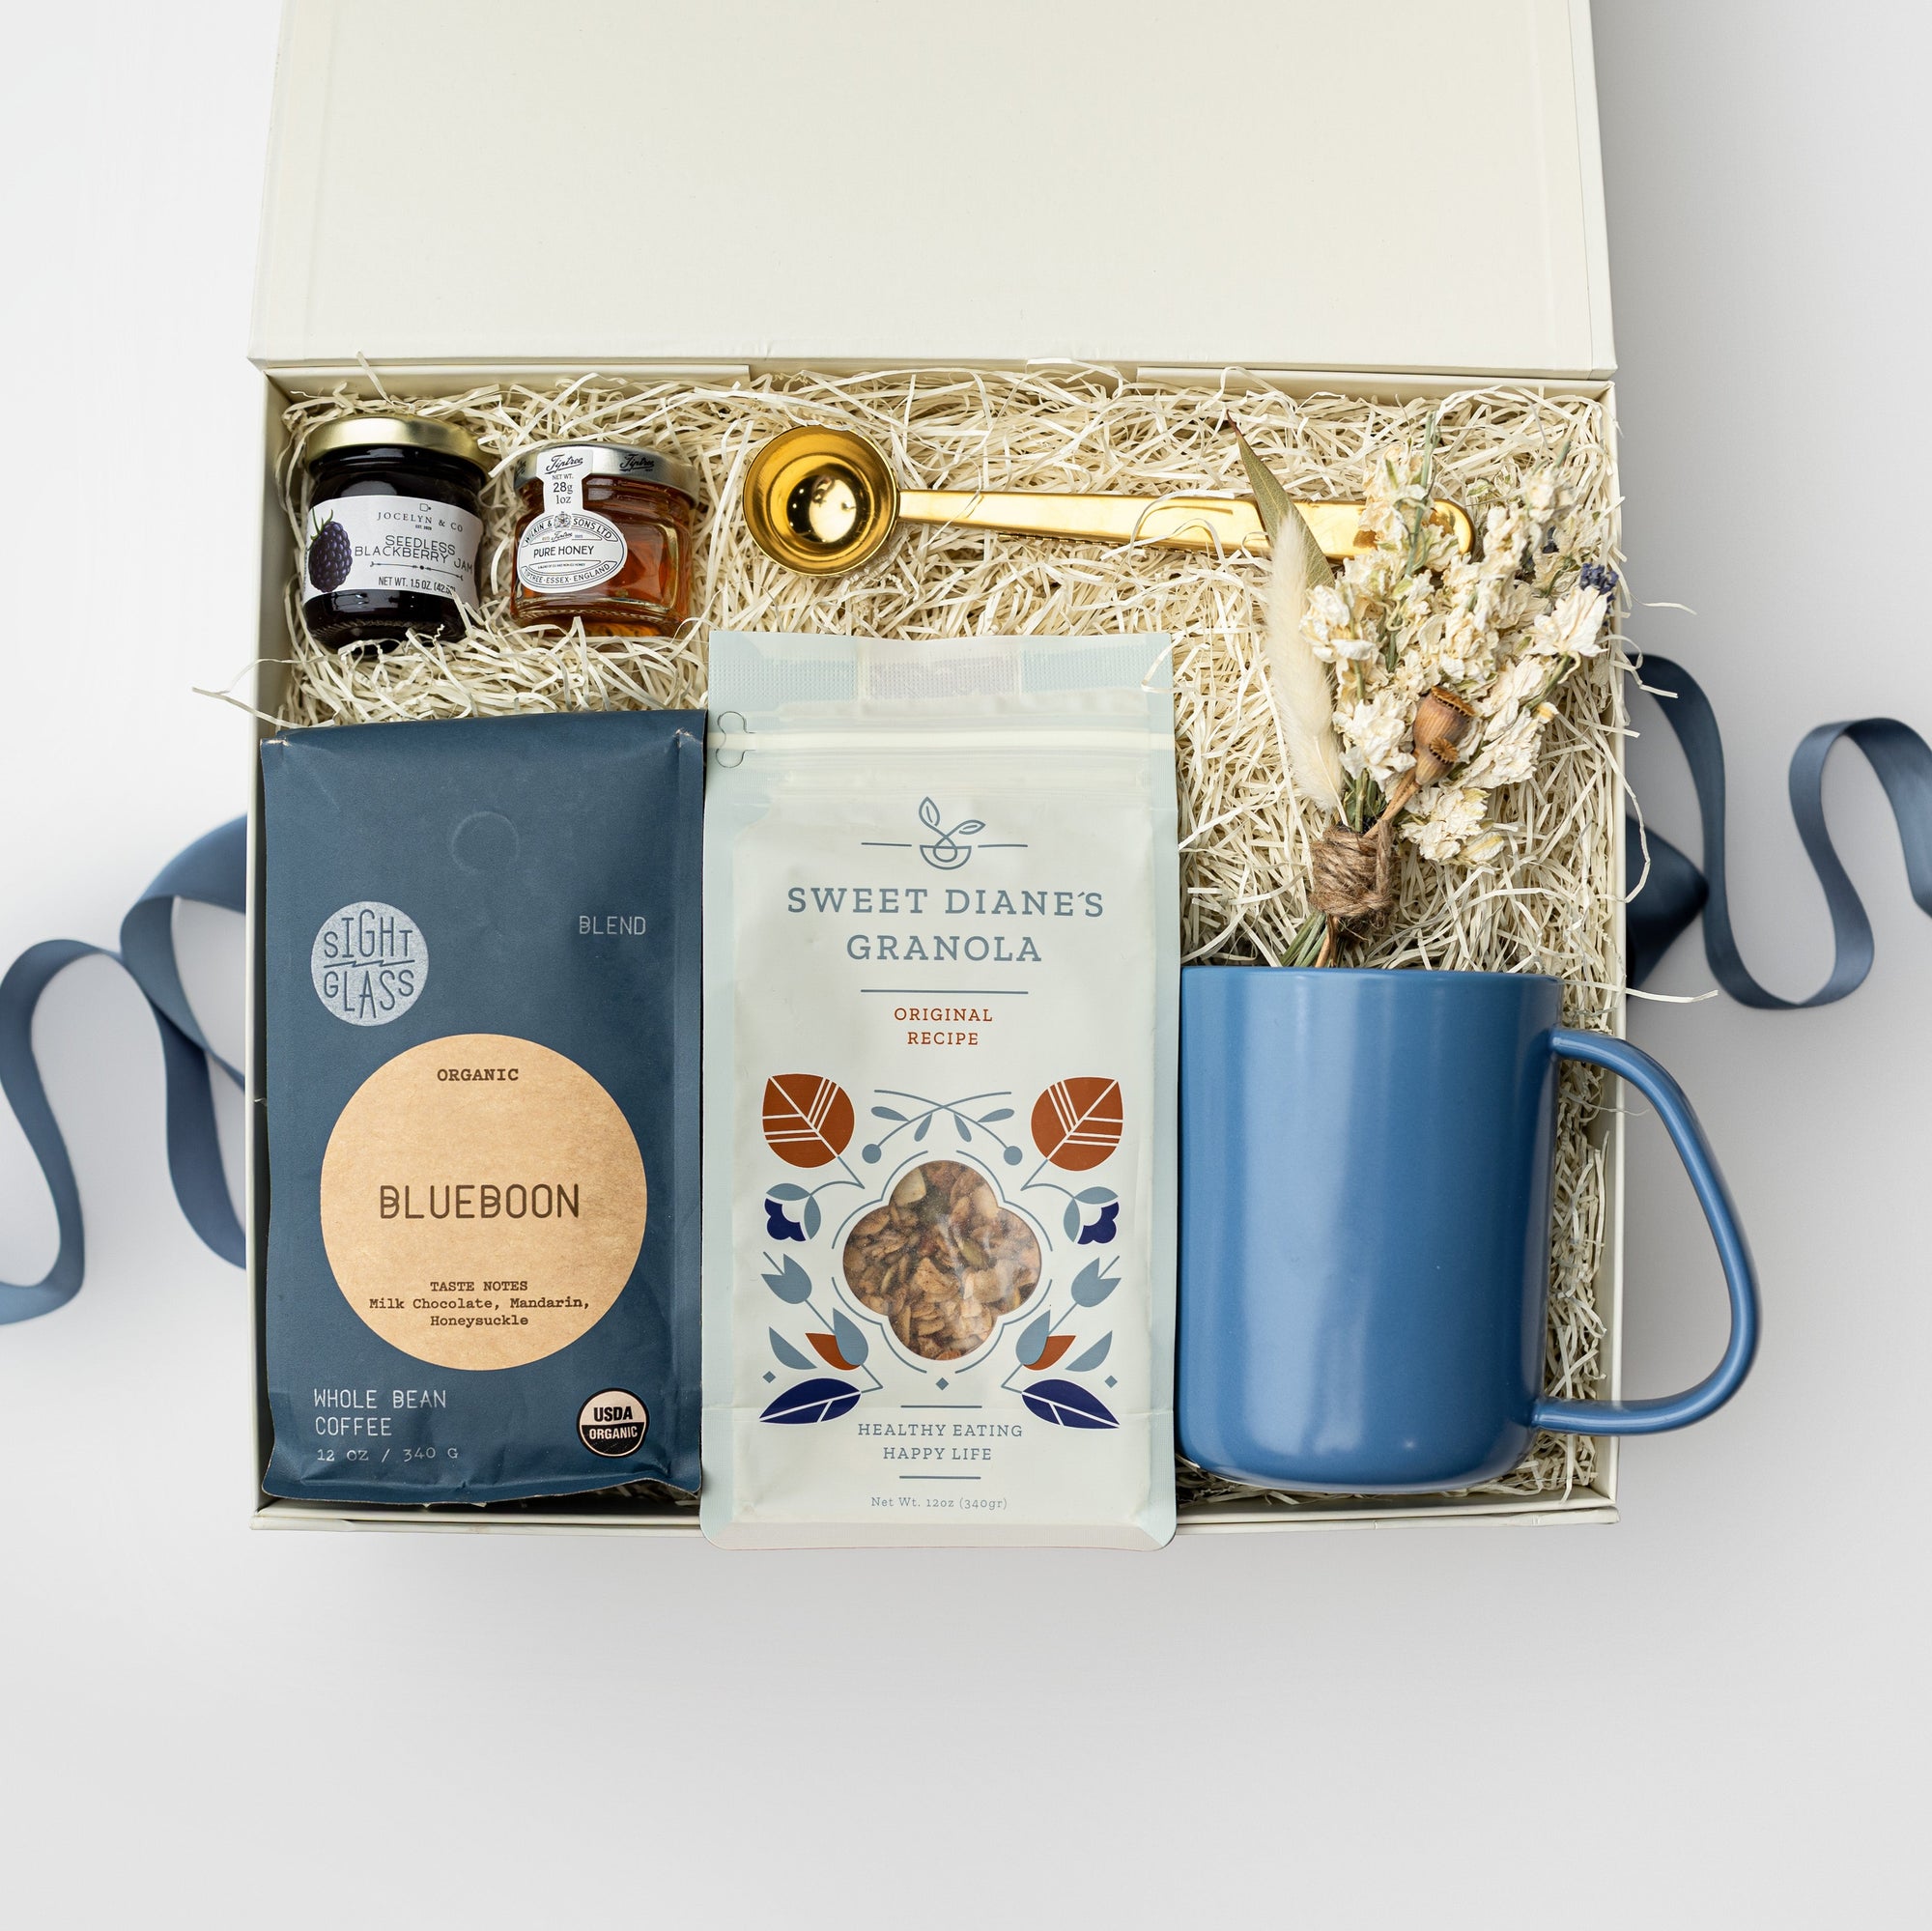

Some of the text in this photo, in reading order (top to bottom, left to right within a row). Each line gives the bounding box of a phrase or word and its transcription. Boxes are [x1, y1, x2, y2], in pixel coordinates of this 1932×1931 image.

[545, 454, 583, 474] Tiptree
[619, 453, 655, 471] Tiptree
[553, 482, 573, 495] 28g
[555, 495, 572, 504] 1oz
[377, 512, 433, 524] JOCELYN
[438, 519, 445, 527] &
[450, 523, 464, 532] CO
[573, 518, 596, 530] SONS
[596, 525, 612, 539] LTD
[384, 535, 456, 555] SEEDLESS
[533, 545, 594, 558] PURE HONEY
[355, 546, 473, 576] BLACKBERRY JAM
[573, 563, 611, 582] ENGLAND
[378, 576, 394, 586] NET
[394, 577, 409, 587] WT.
[411, 578, 421, 588] 1.5
[421, 580, 432, 590] OZ.
[787, 887, 1104, 918] SWEET DIANE'S
[324, 908, 413, 958] SIGHT
[579, 915, 647, 935] BLEND
[846, 934, 1042, 962] GRANOLA
[324, 969, 414, 1019] GLASS
[894, 1008, 993, 1023] ORIGINAL
[907, 1032, 979, 1046] RECIPE
[437, 1068, 519, 1082] ORGANIC
[380, 1183, 580, 1219] BLUEBOON
[430, 1280, 528, 1292] TASTE NOTES
[369, 1296, 589, 1312] Milk Chocolate, Mandarin,
[430, 1315, 529, 1328] Honeysuckle
[313, 1388, 447, 1409] WHOLE BEAN
[593, 1406, 633, 1422] USDA
[315, 1417, 392, 1436] COFFEE
[588, 1426, 638, 1440] ORGANIC
[858, 1423, 1023, 1437] HEALTHY EATING
[317, 1449, 335, 1462] 12
[381, 1448, 390, 1462] /
[403, 1447, 437, 1462] 340
[447, 1448, 459, 1460] G
[883, 1446, 992, 1461] HAPPY LIFE
[870, 1496, 1008, 1511] Net Wt. 12oz (340gr)
